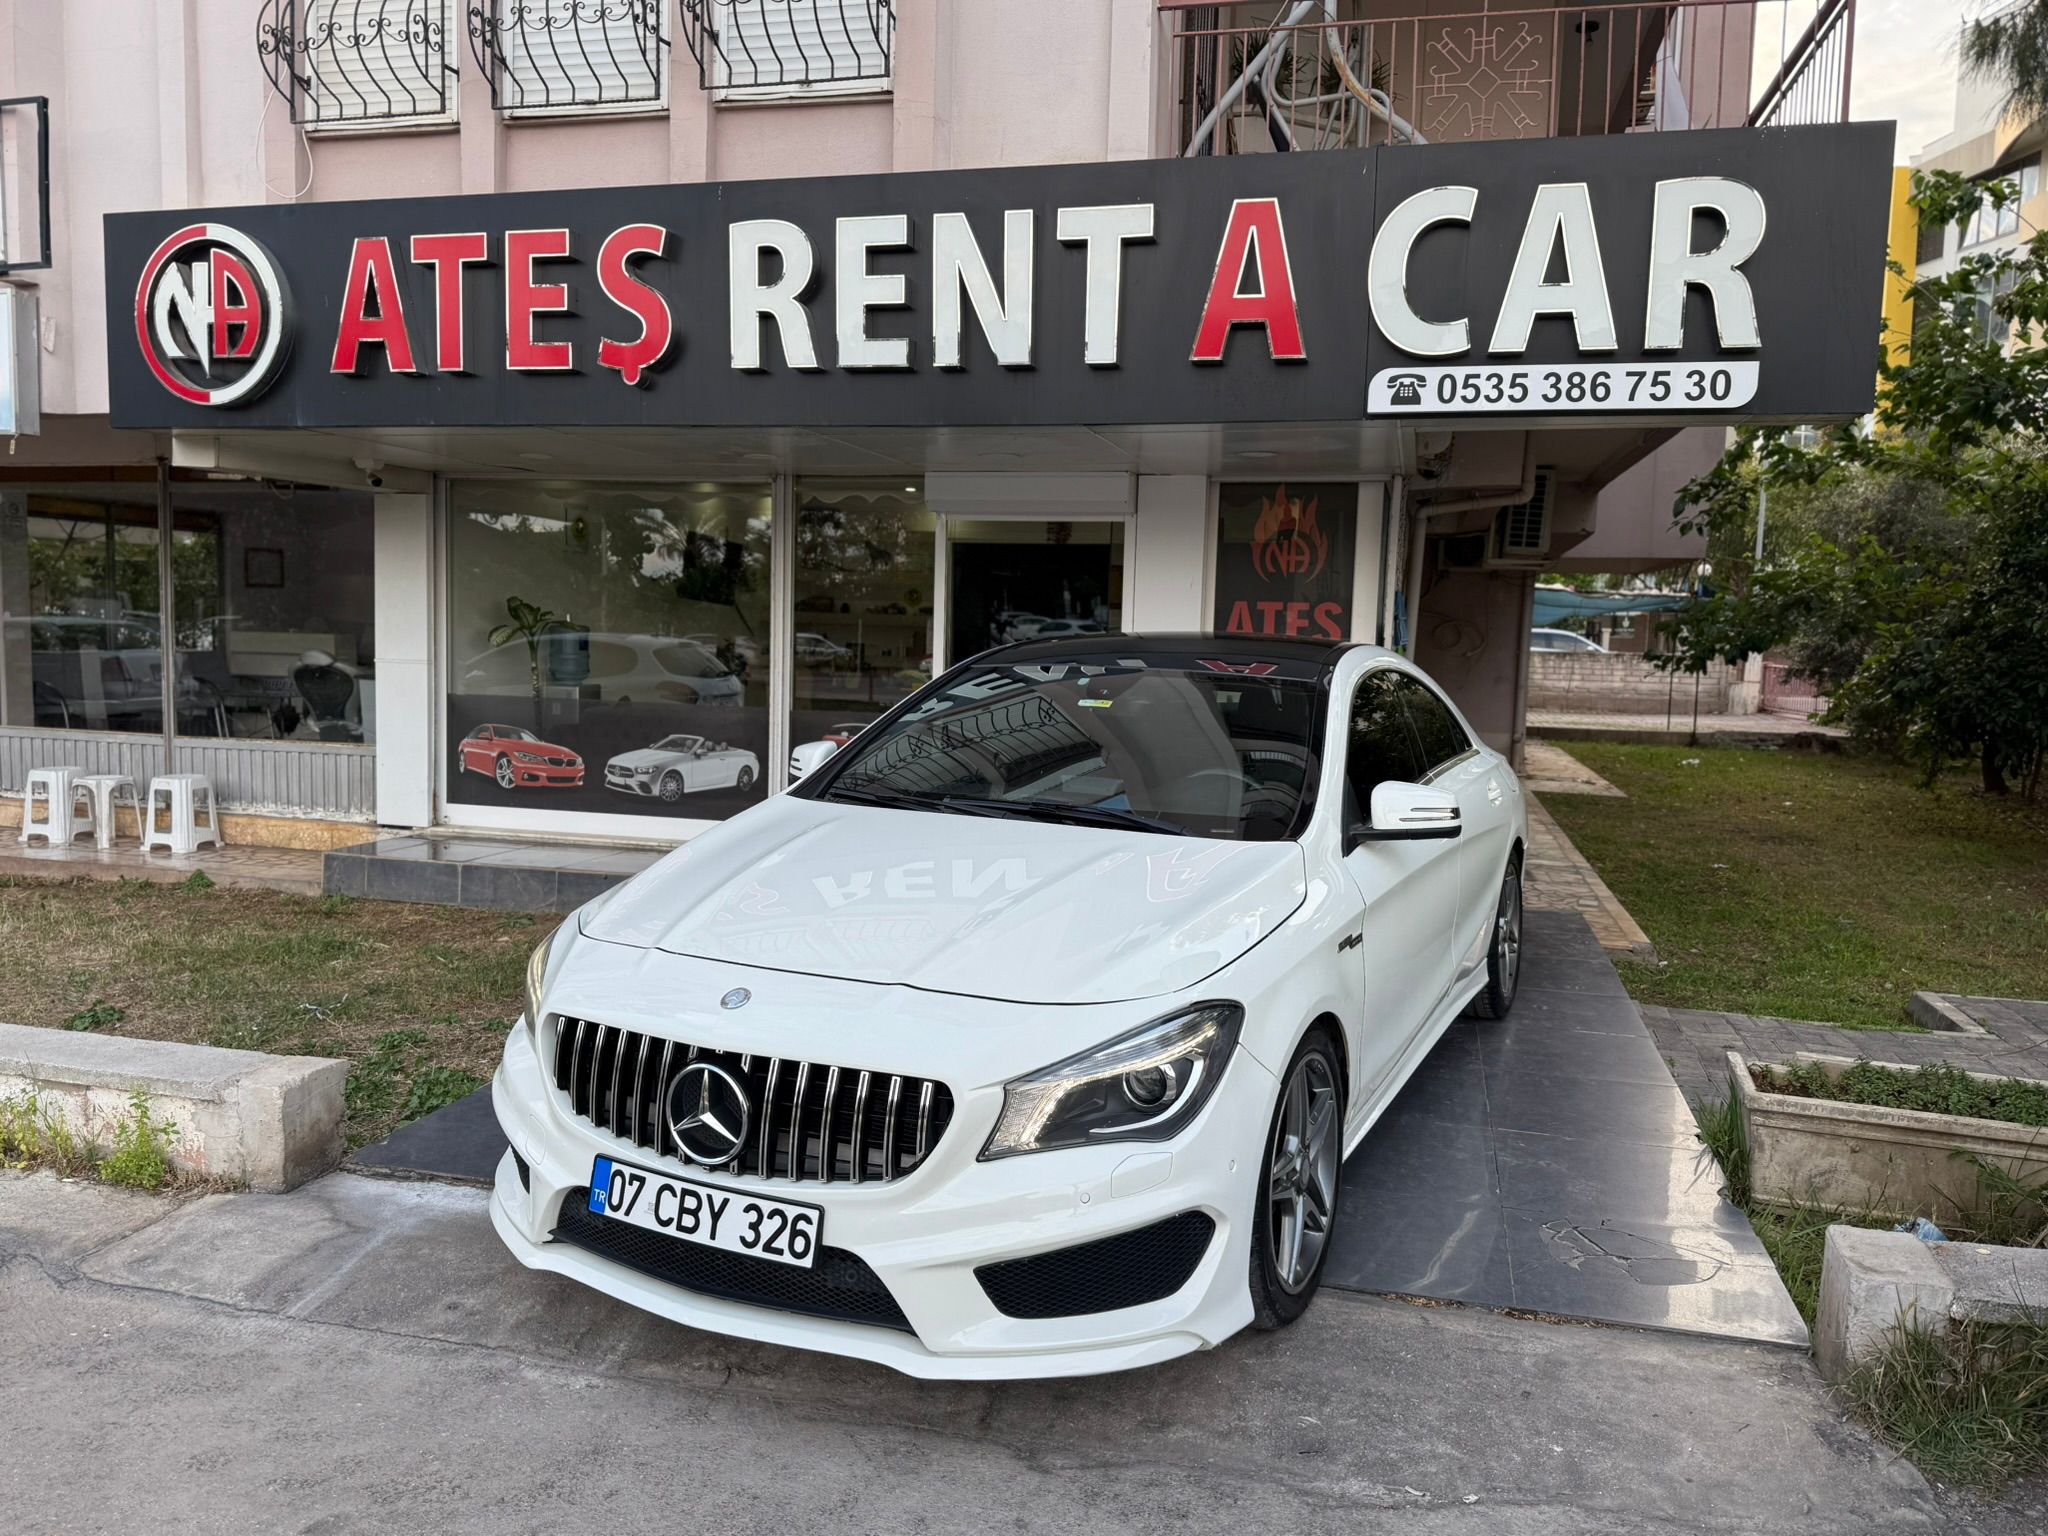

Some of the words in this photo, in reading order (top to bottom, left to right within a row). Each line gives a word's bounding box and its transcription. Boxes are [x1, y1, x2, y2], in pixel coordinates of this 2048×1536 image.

[330, 222, 674, 386] ATEŞ
[728, 203, 1155, 369] RENT
[1189, 197, 1308, 362] A
[1367, 176, 1767, 356] CAR
[1436, 372, 1529, 404] 0535
[1541, 370, 1612, 403] 386
[1625, 369, 1672, 402] 75
[1684, 368, 1732, 402] 30
[594, 1188, 606, 1204] TR
[607, 1169, 646, 1217] 07
[654, 1183, 730, 1241] CBY
[739, 1203, 814, 1260] 326
